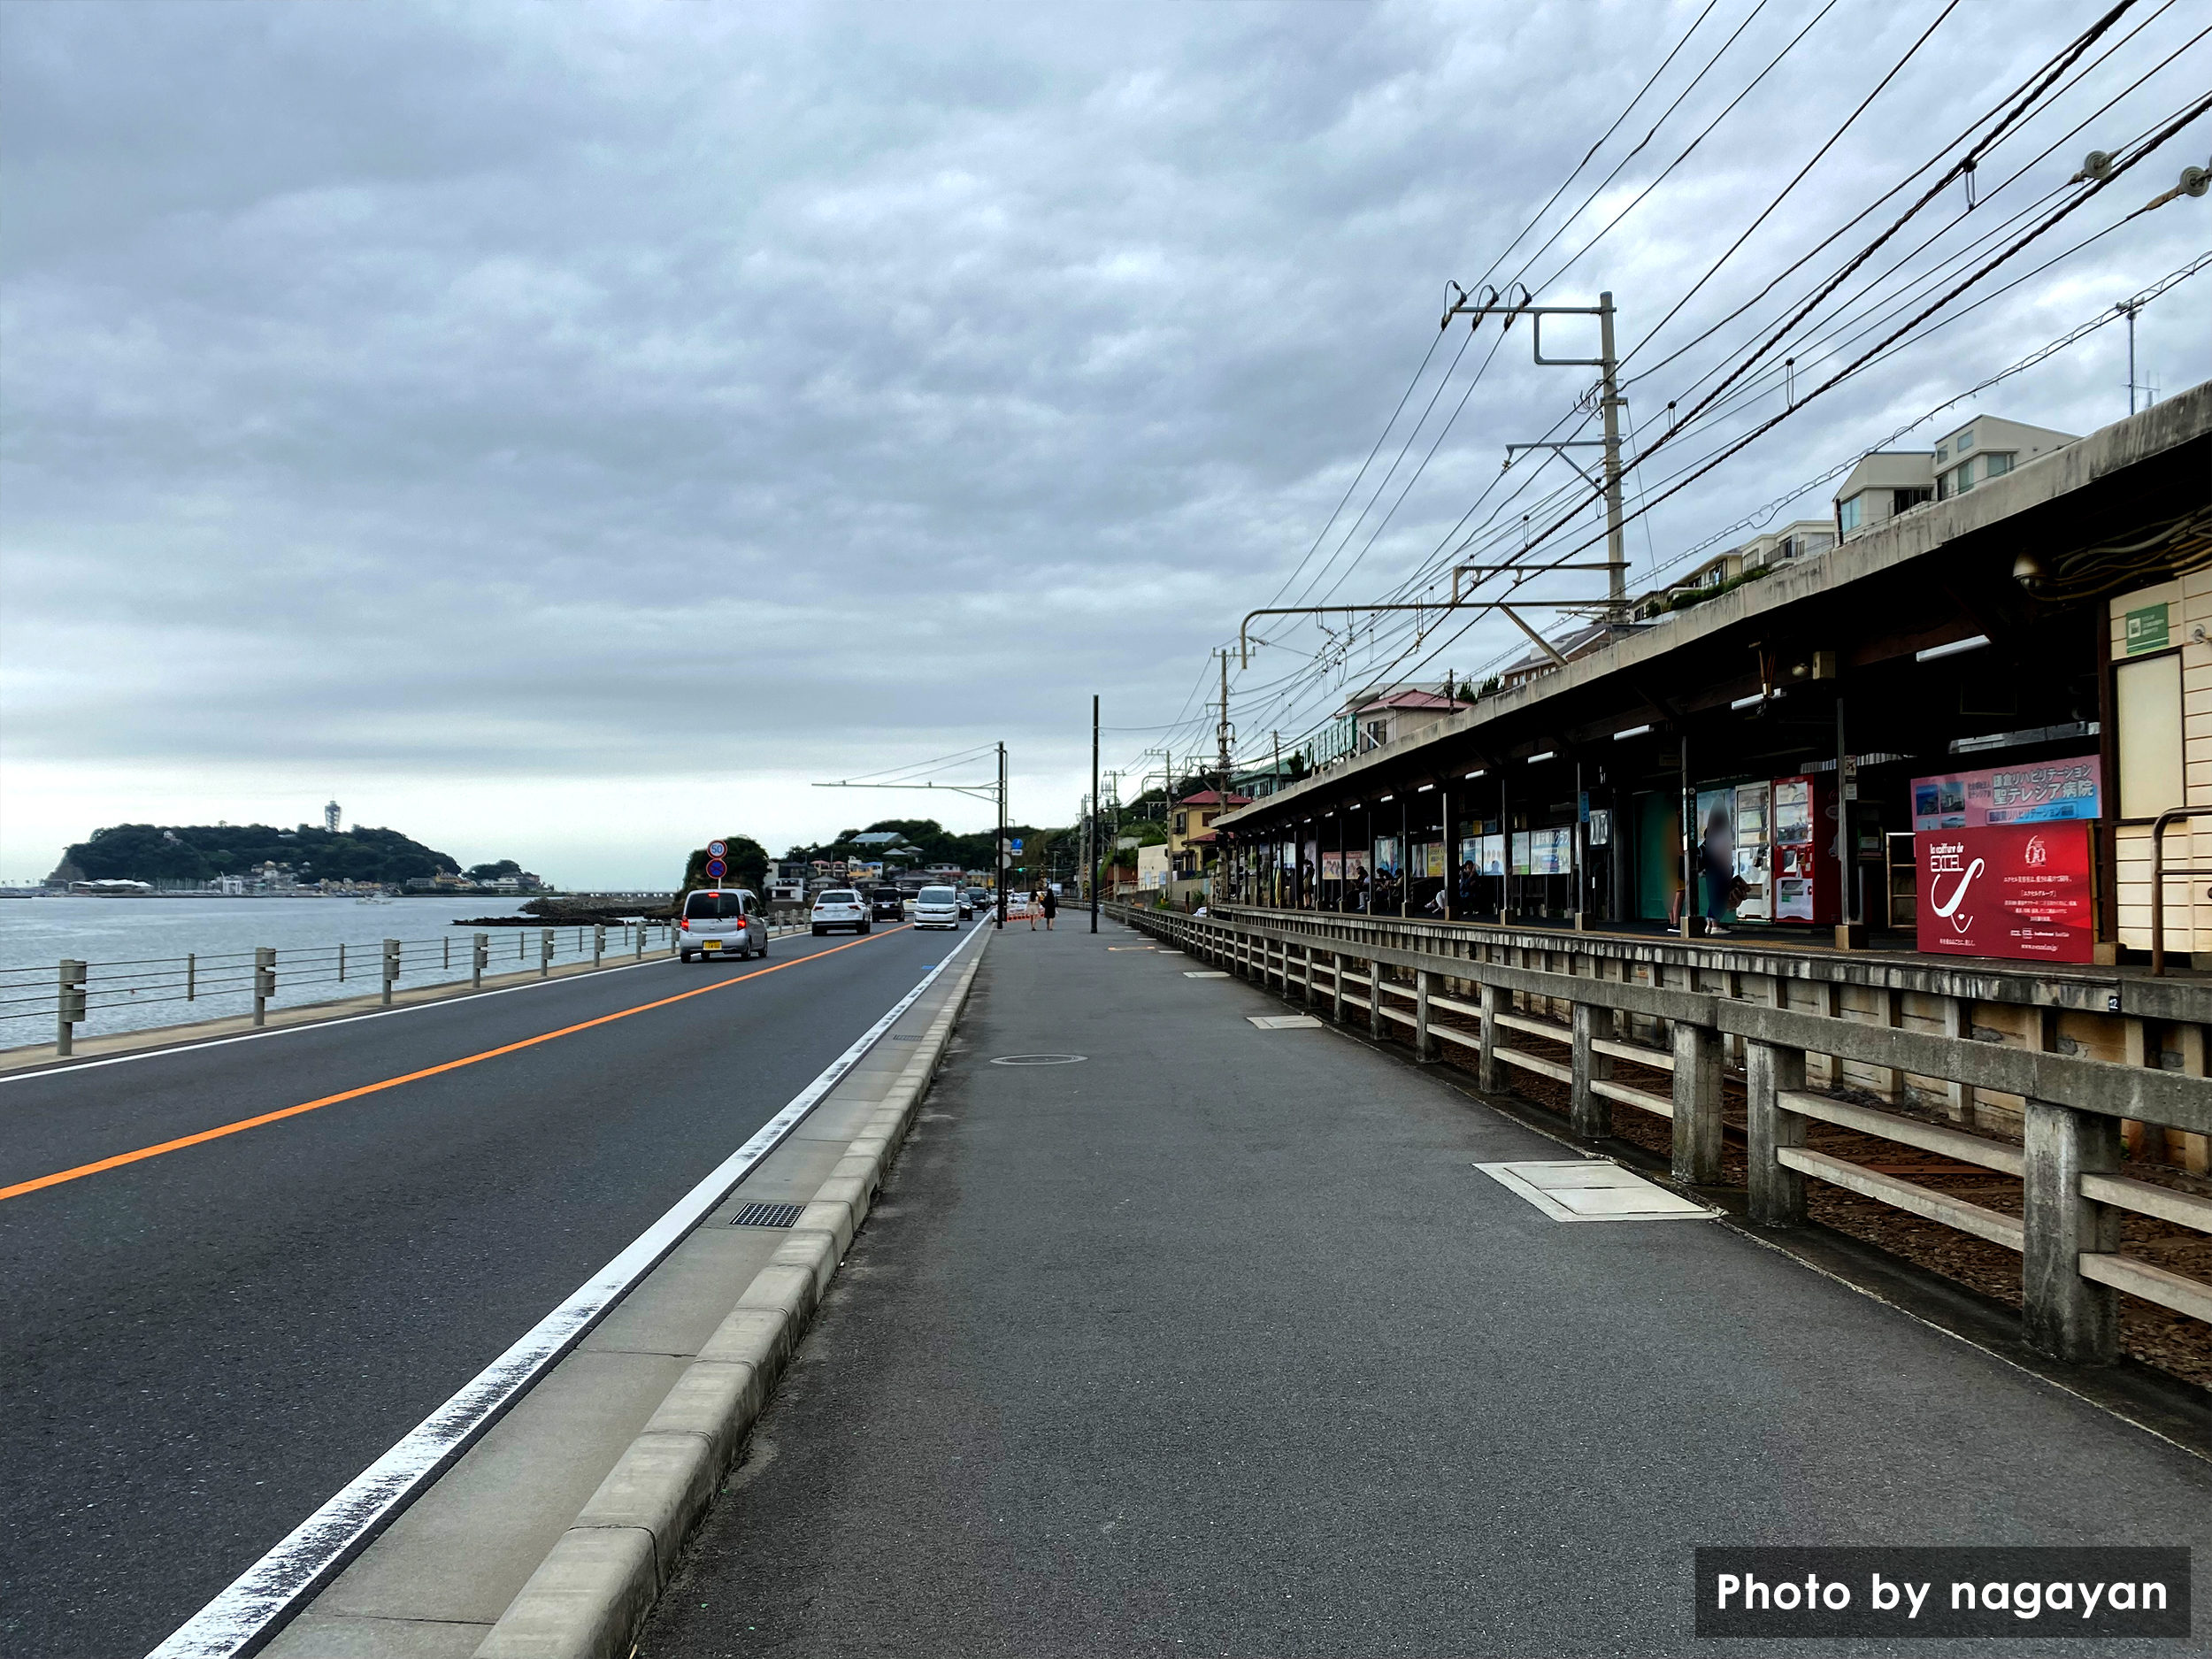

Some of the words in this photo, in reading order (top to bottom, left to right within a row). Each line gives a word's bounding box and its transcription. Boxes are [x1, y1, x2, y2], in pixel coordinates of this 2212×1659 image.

[1993, 764, 2093, 787] 鎌倉リハビリテーション
[1993, 780, 2093, 805] 聖テレジア病院
[711, 845, 723, 854] 50
